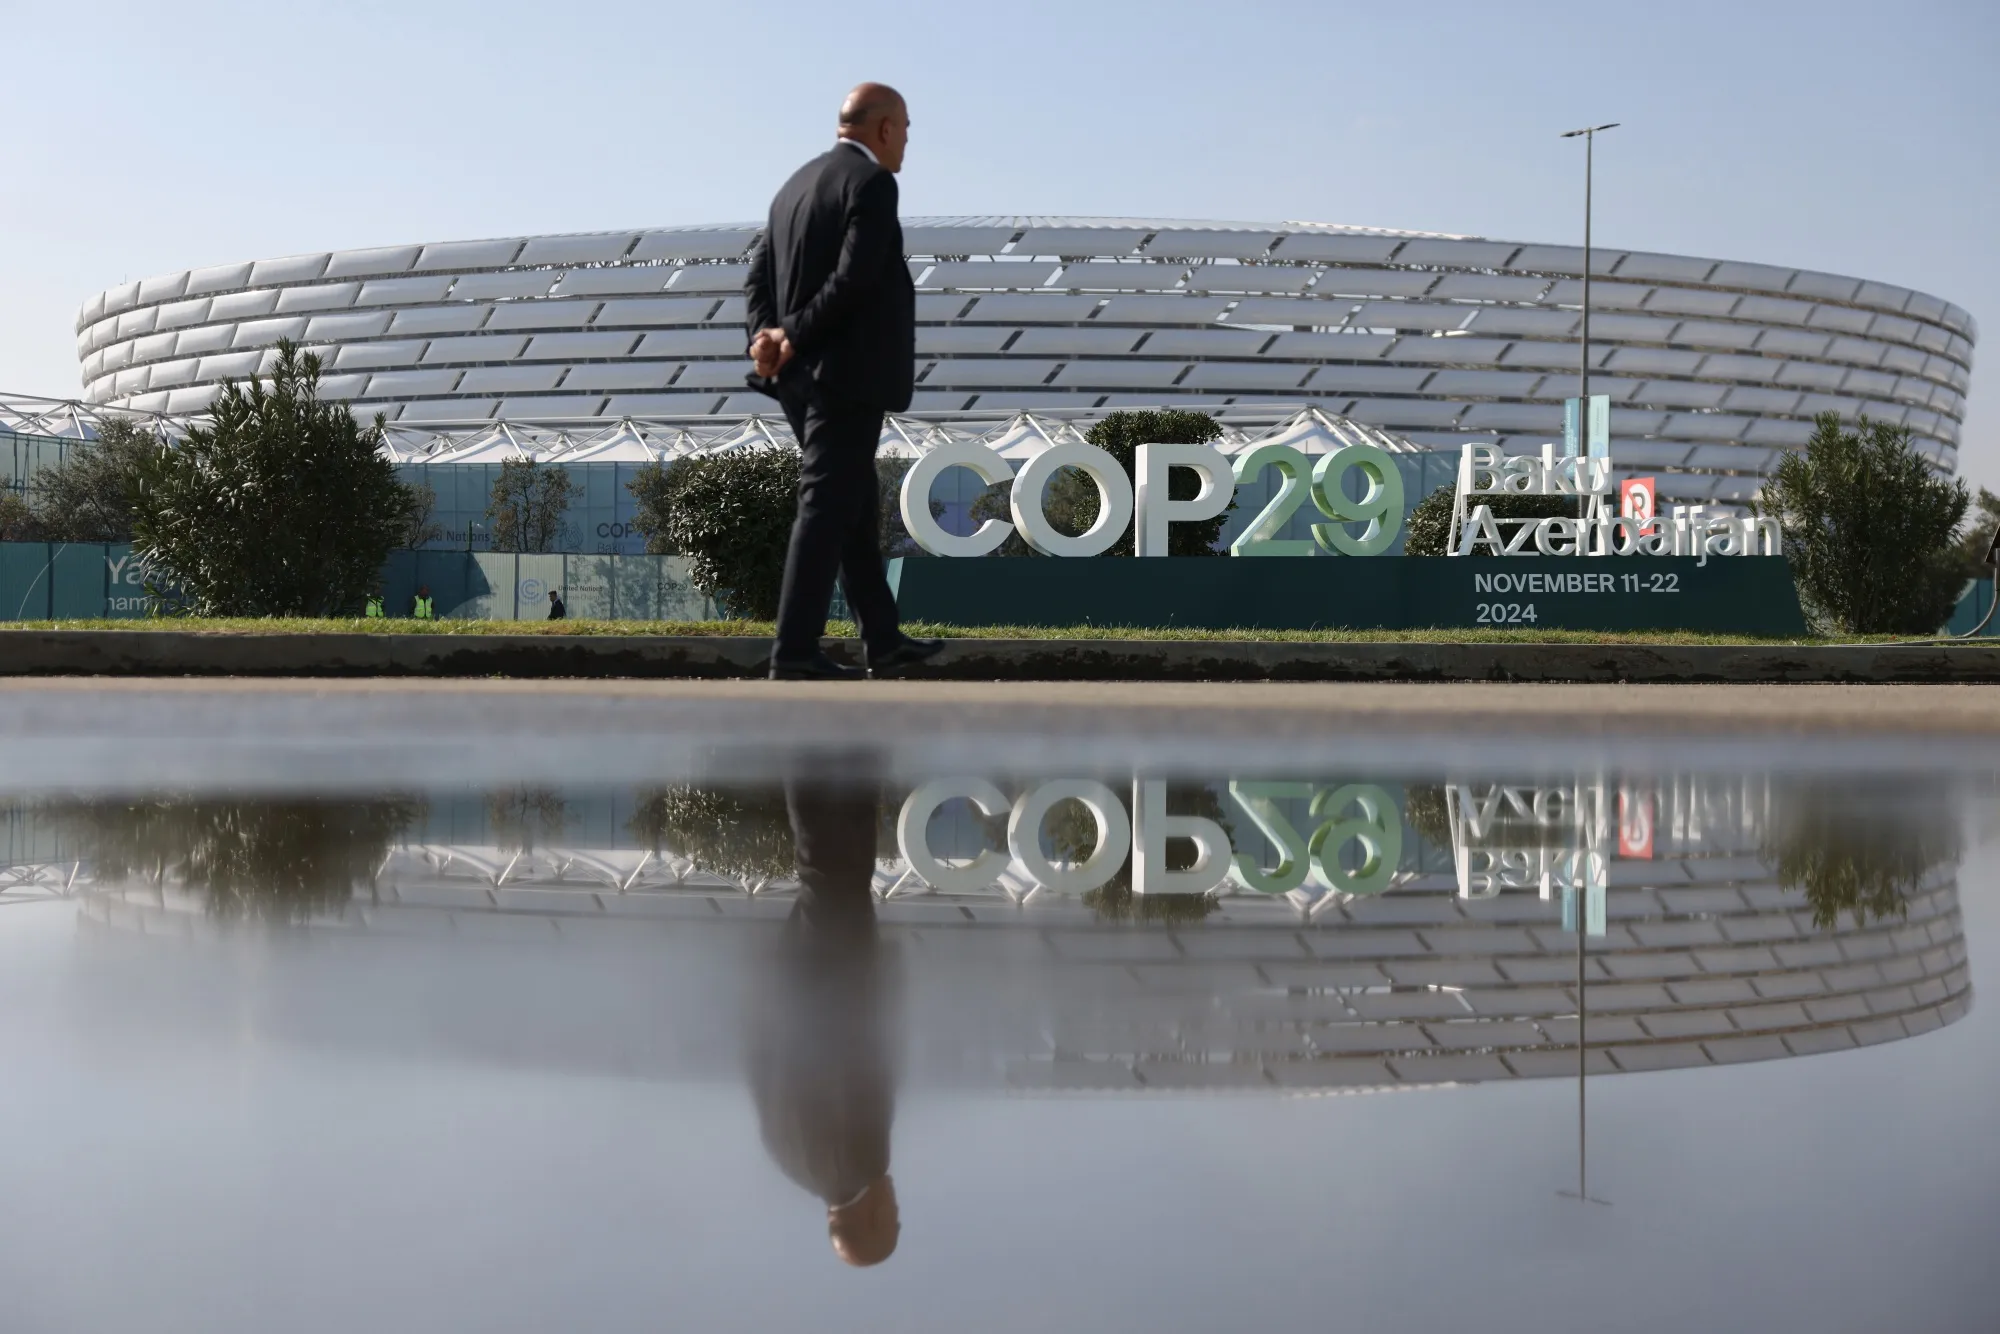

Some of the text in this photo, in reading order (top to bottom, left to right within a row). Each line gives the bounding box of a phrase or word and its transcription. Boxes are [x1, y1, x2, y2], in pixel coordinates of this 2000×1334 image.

[1462, 443, 1612, 494] Baku
[900, 443, 1403, 556] COP29
[446, 530, 490, 542] Natons
[597, 522, 645, 539] COP
[1459, 505, 1782, 567] Azerbaijan
[1474, 573, 1680, 593] NOVEMBER 11-22
[1476, 604, 1537, 623] 2024
